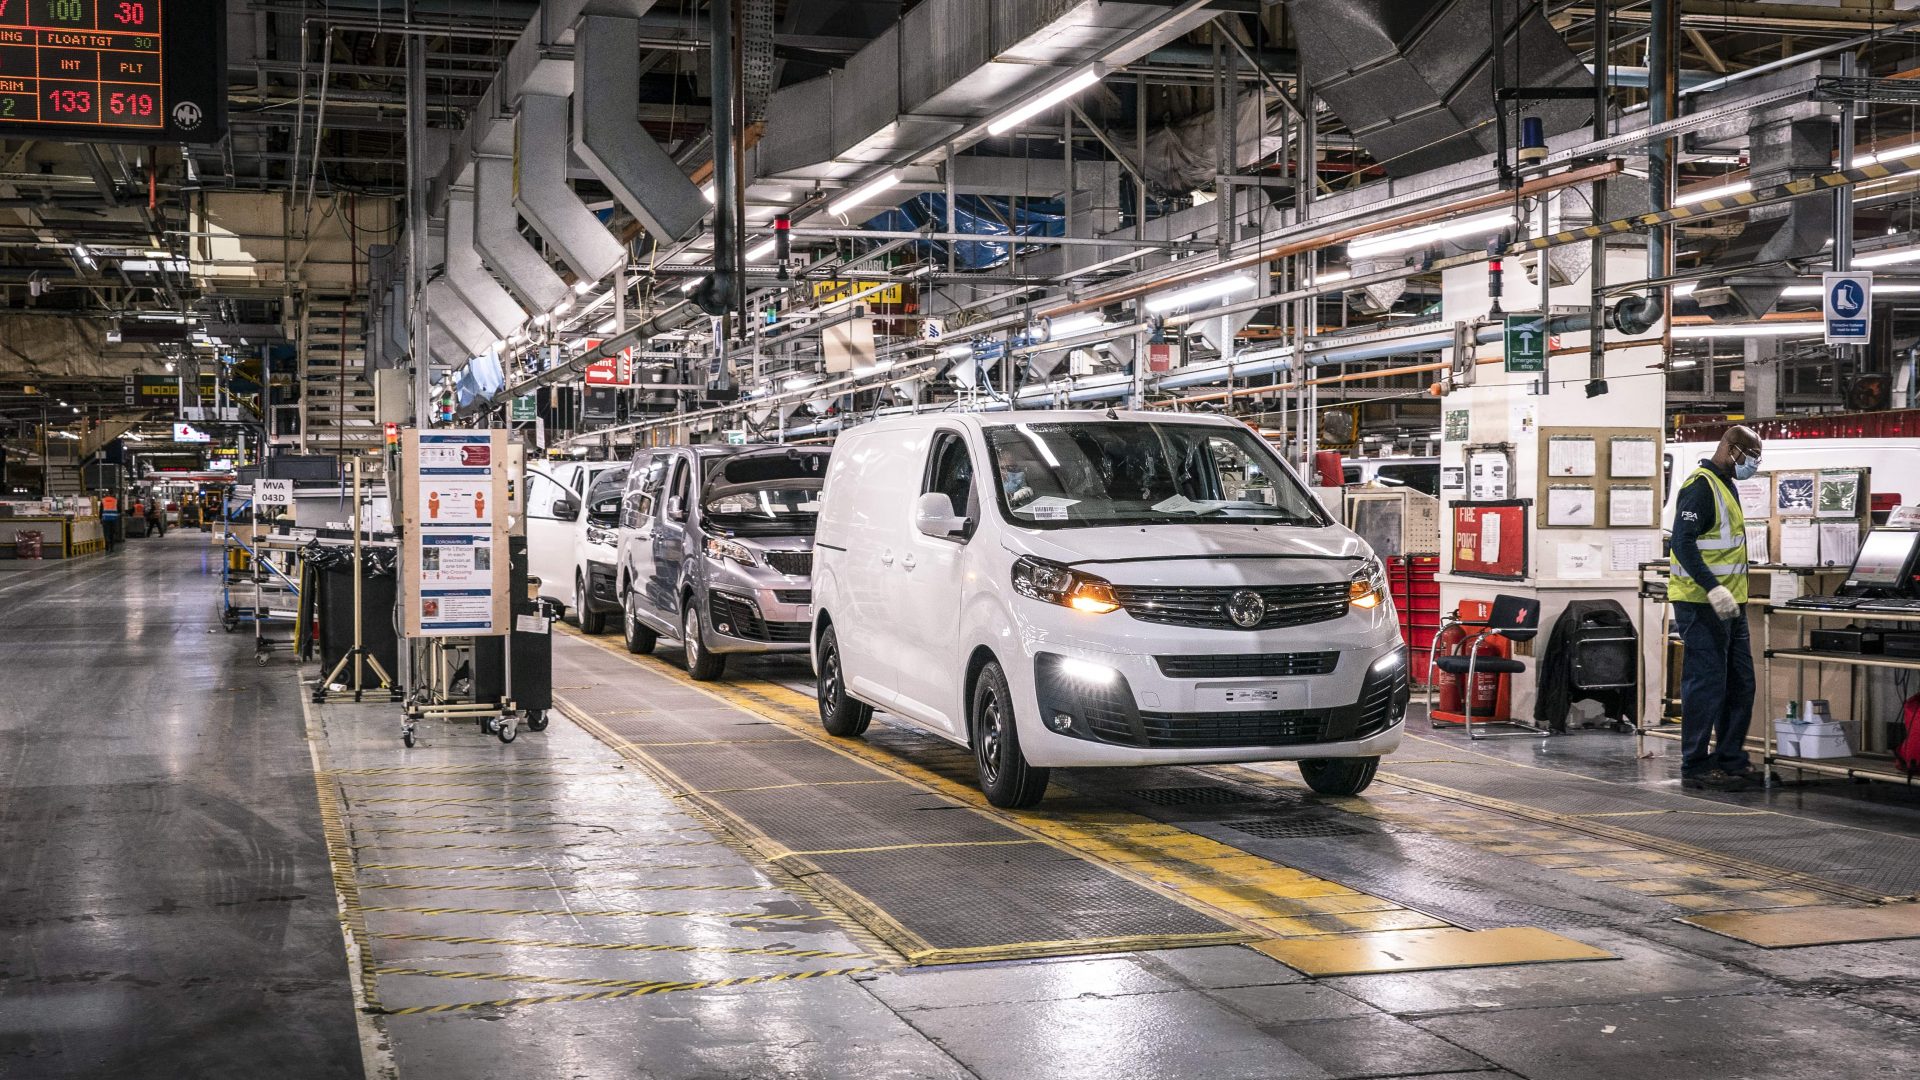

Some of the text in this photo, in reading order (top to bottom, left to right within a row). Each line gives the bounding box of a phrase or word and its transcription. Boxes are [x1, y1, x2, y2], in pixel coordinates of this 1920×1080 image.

[47, 0, 82, 21] 100
[48, 33, 87, 46] FLOAT
[88, 36, 113, 47] TGT
[61, 59, 81, 70] INT
[120, 62, 144, 74] PLT
[49, 90, 91, 112] 133
[110, 93, 153, 116] 519
[263, 482, 285, 490] MVA
[262, 494, 285, 502] 043D
[1459, 507, 1476, 523] FIRE
[1456, 532, 1477, 548] POINT
